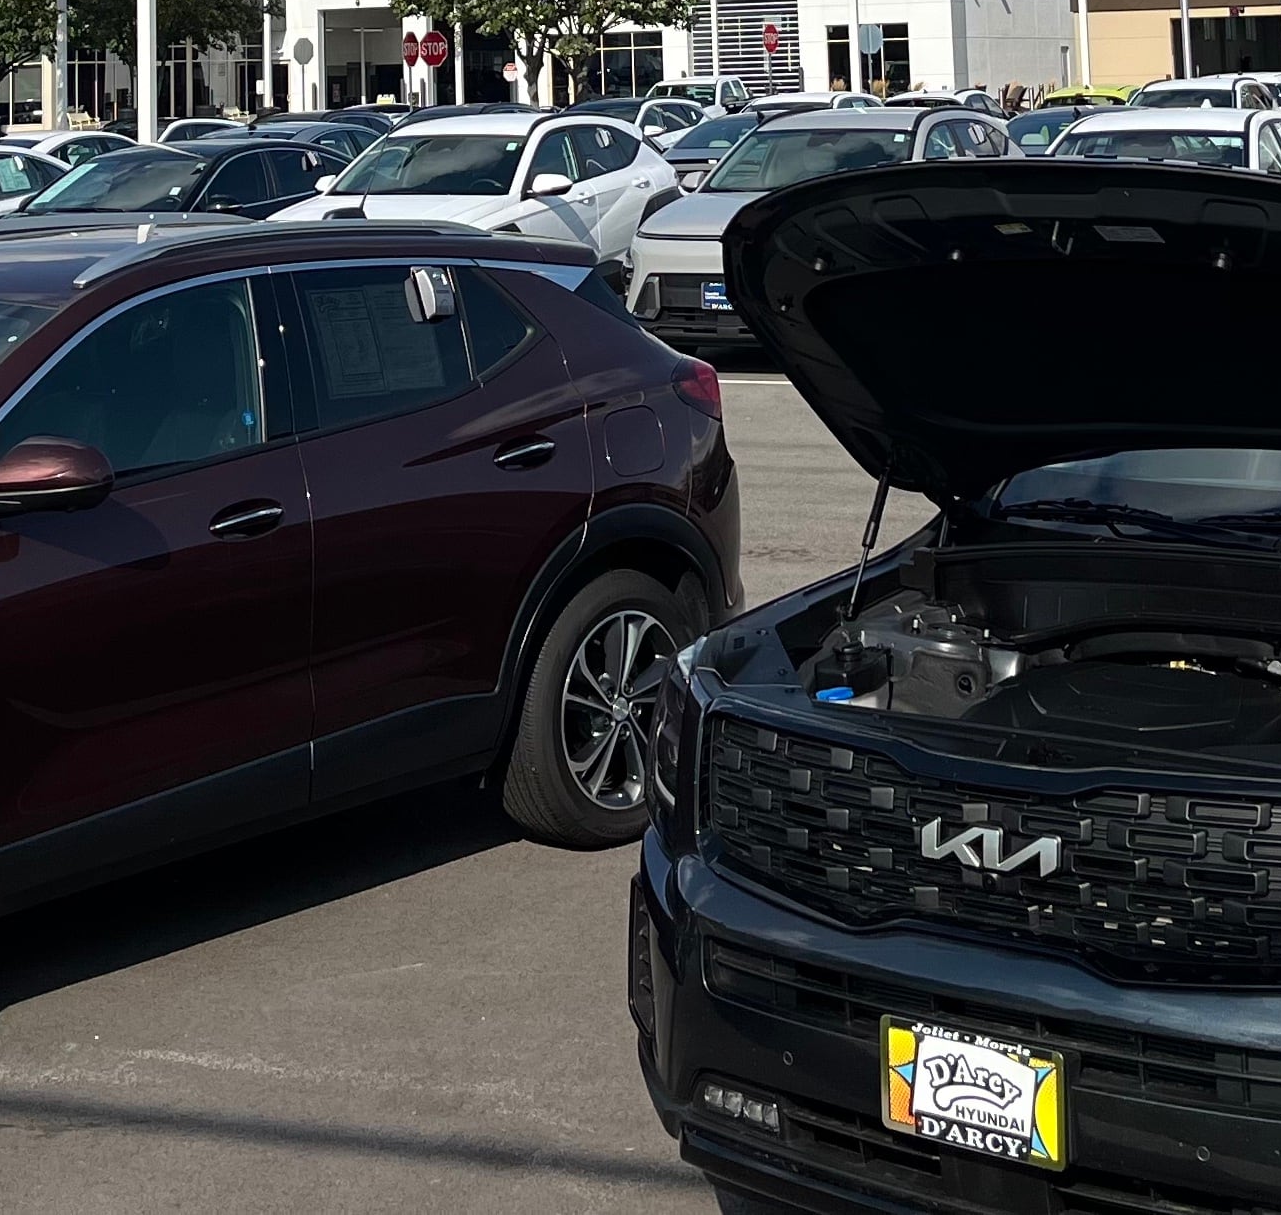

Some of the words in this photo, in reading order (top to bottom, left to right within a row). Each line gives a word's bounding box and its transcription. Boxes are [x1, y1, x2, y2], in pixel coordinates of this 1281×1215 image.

[403, 42, 418, 56] STOP
[421, 42, 446, 56] STOP
[764, 33, 778, 44] STOP
[921, 816, 1061, 878] KIA
[911, 1022, 960, 1042] Joliet
[974, 1034, 1031, 1057] Morris
[923, 1053, 1022, 1101] D'Arcy
[955, 1104, 1025, 1133] HYUNDAI
[921, 1115, 1023, 1158] D'ARCY
